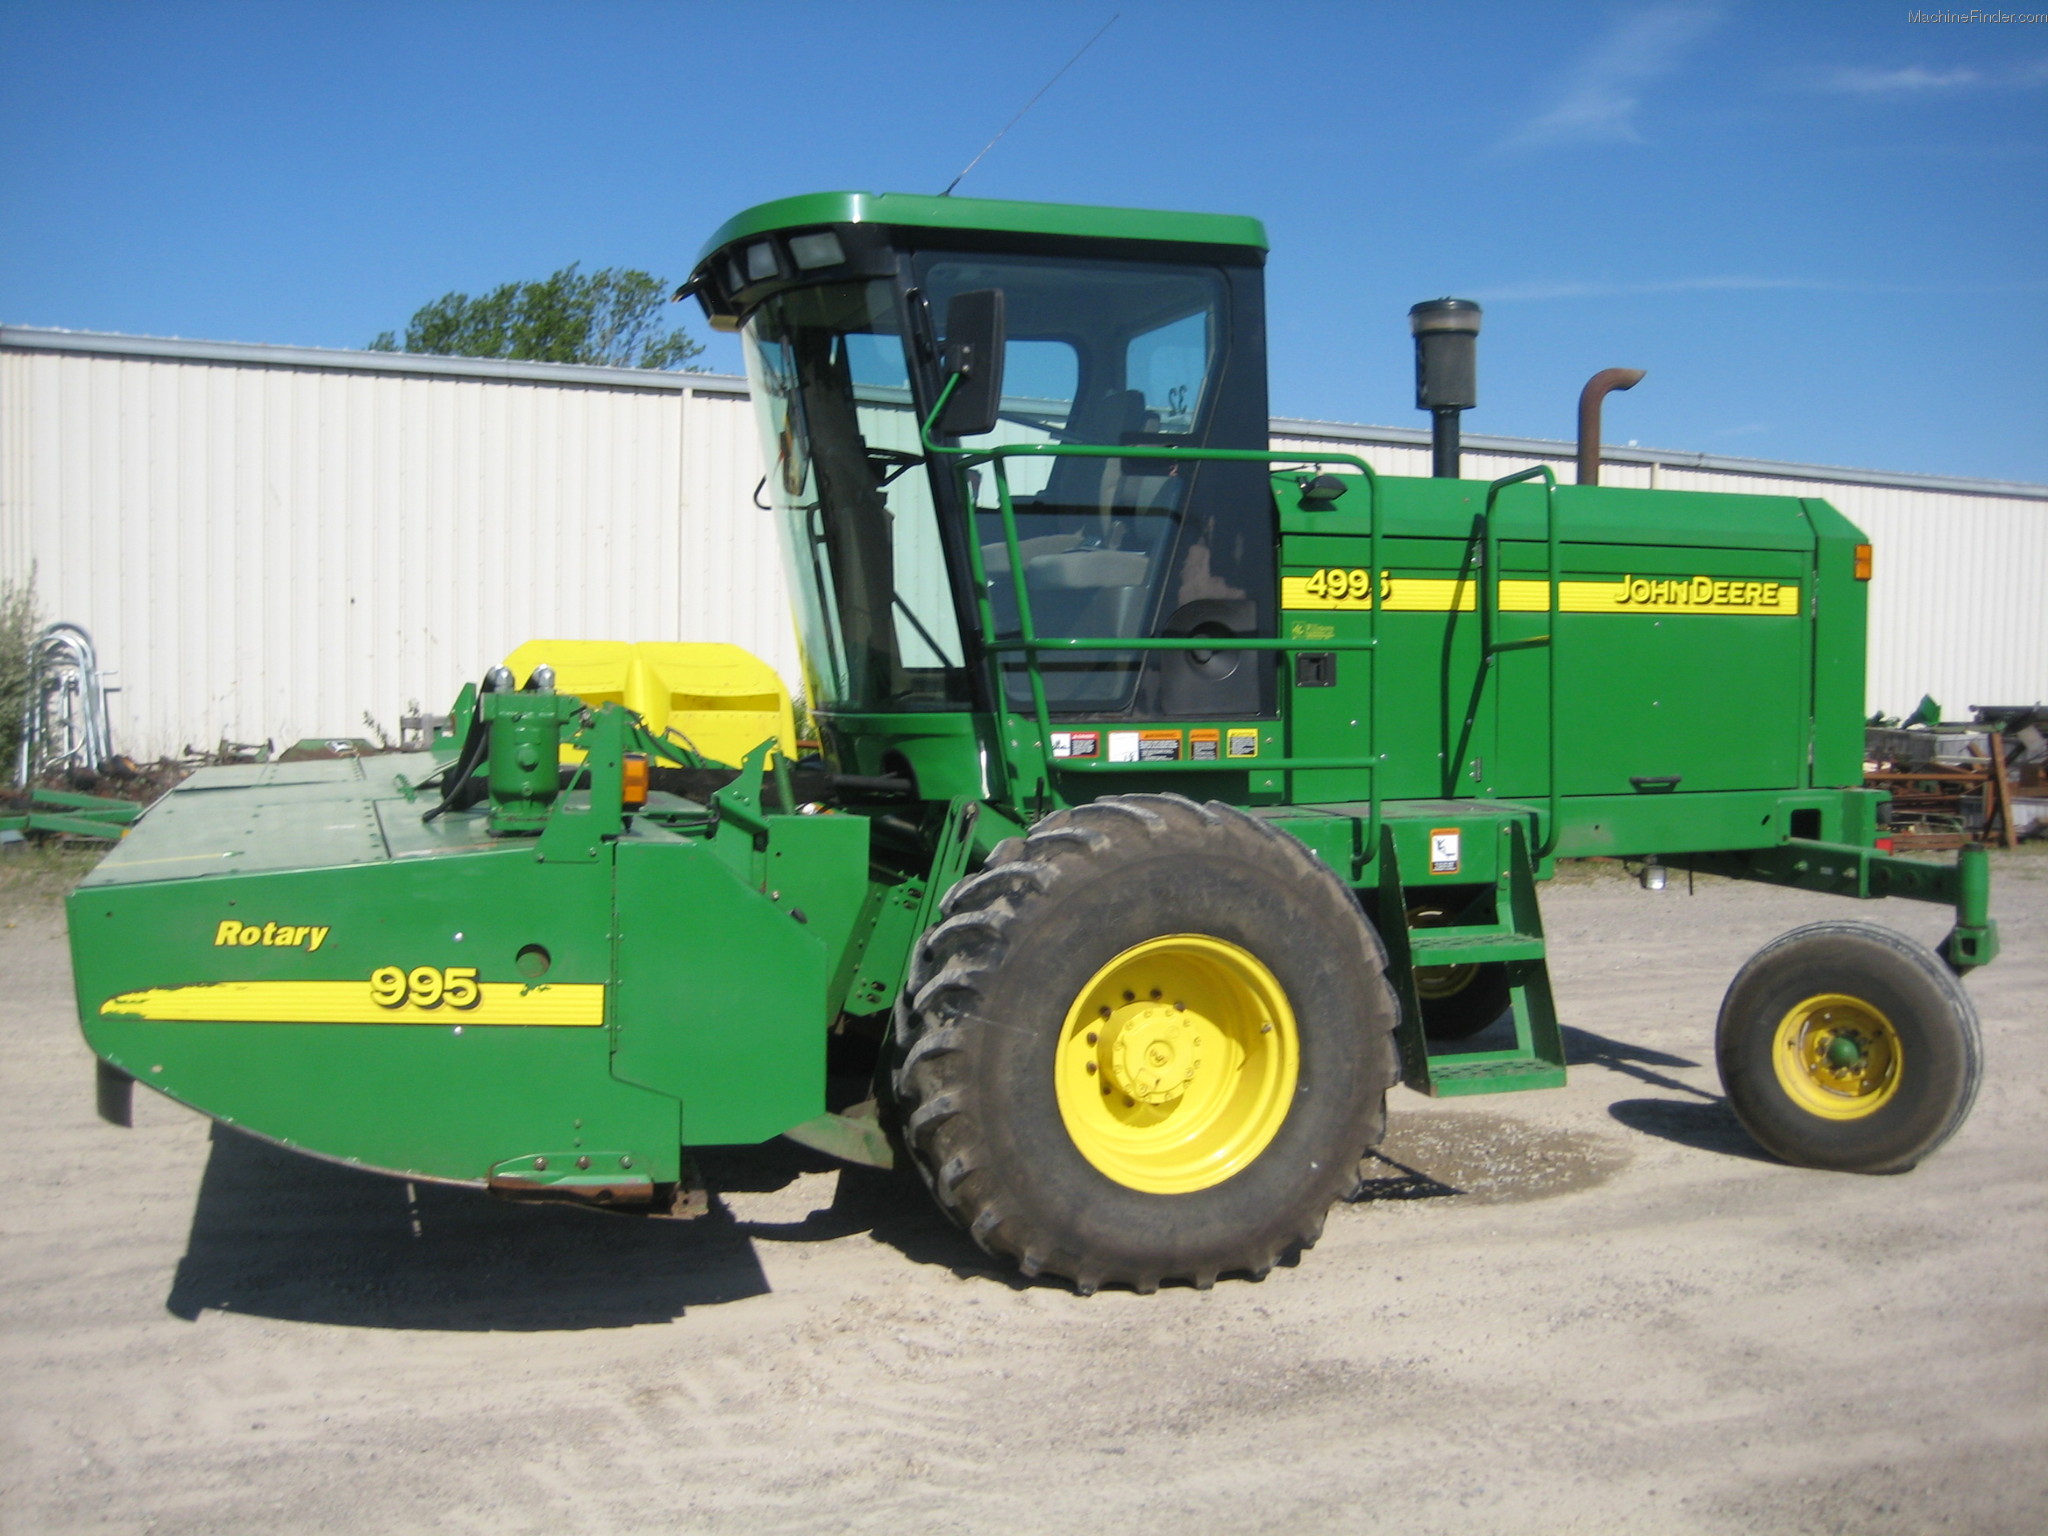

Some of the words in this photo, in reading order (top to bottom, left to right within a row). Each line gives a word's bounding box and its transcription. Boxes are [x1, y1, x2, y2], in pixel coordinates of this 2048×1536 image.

[1616, 574, 1689, 604] JOHN
[1691, 576, 1779, 606] DEERE
[214, 920, 330, 952] Rotary
[370, 965, 482, 1010] 995
